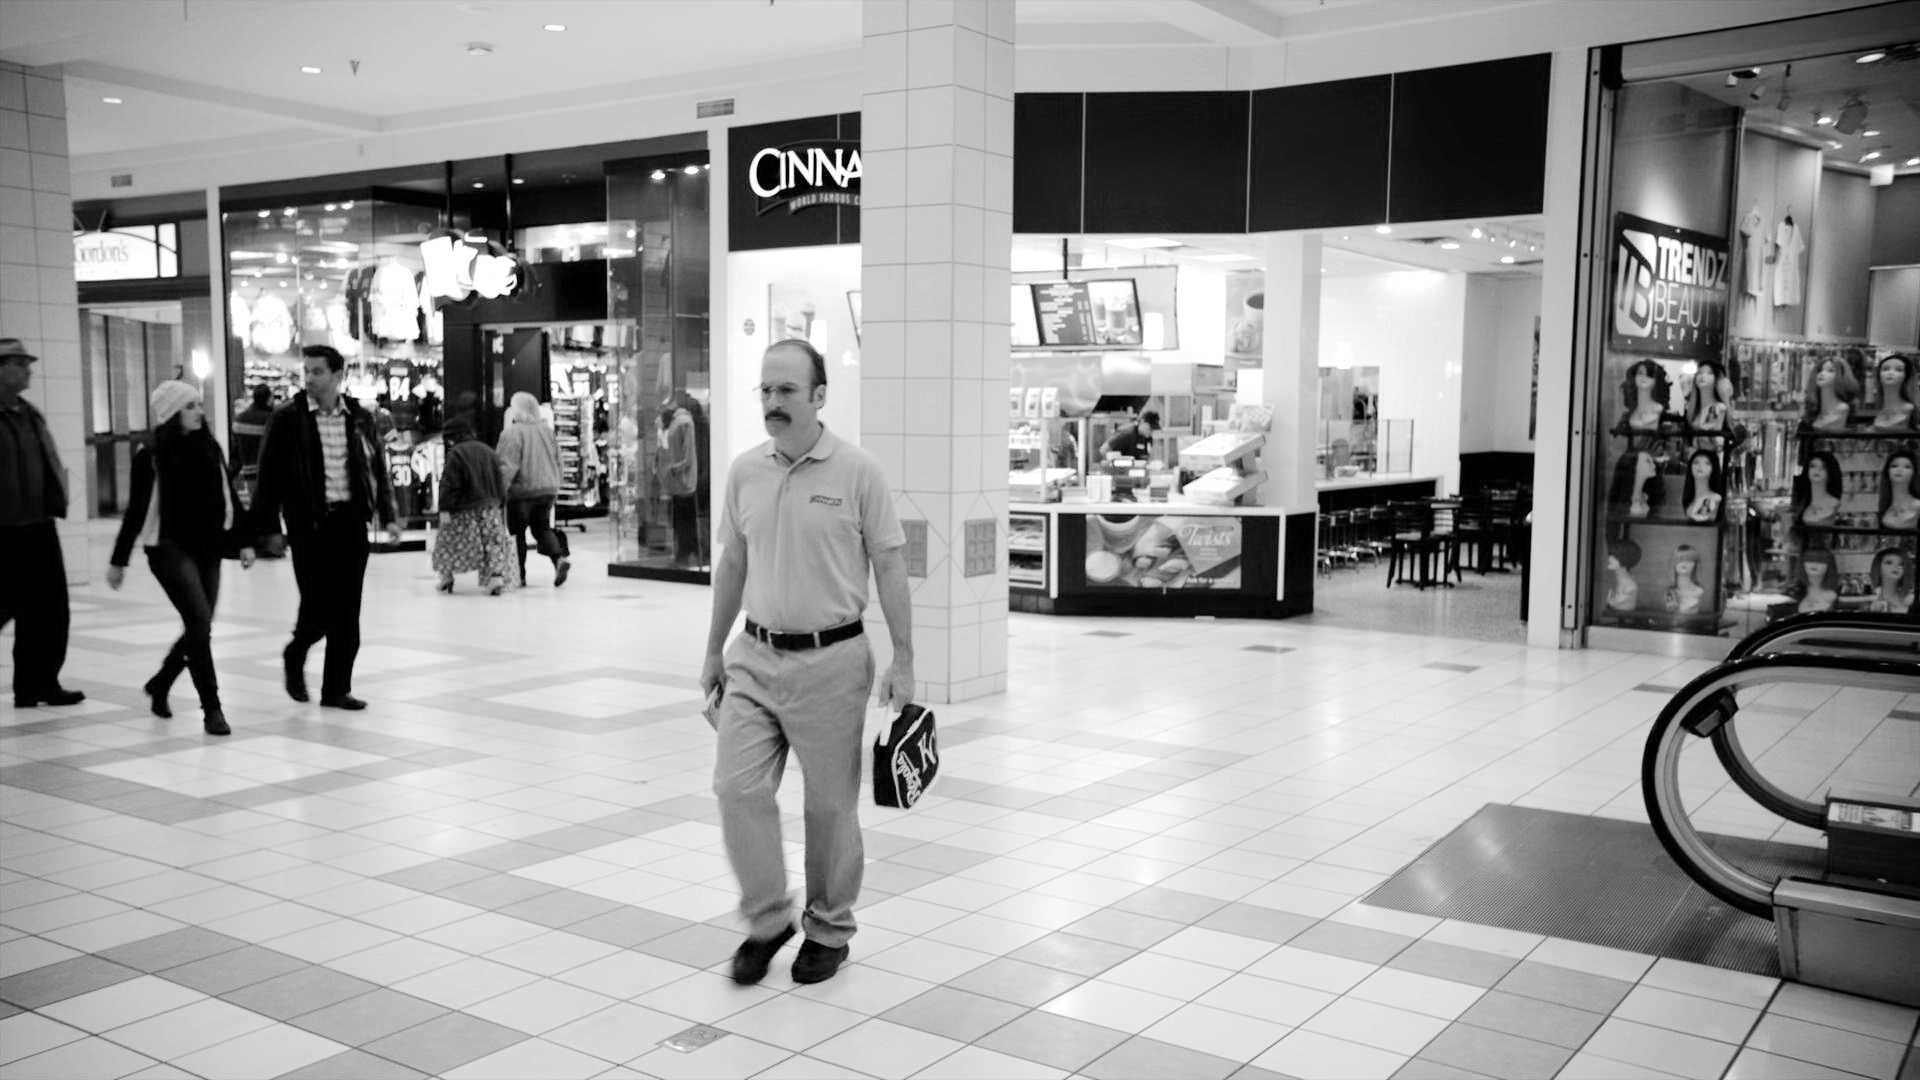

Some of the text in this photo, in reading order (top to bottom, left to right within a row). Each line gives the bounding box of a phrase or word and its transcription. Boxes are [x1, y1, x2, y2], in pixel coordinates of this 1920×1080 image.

[749, 147, 862, 198] CINNA
[788, 194, 817, 213] WORLD
[819, 192, 850, 205] FAMOUS
[1657, 236, 1729, 290] TRENDZ
[389, 377, 411, 402] 84
[392, 465, 412, 487] 30
